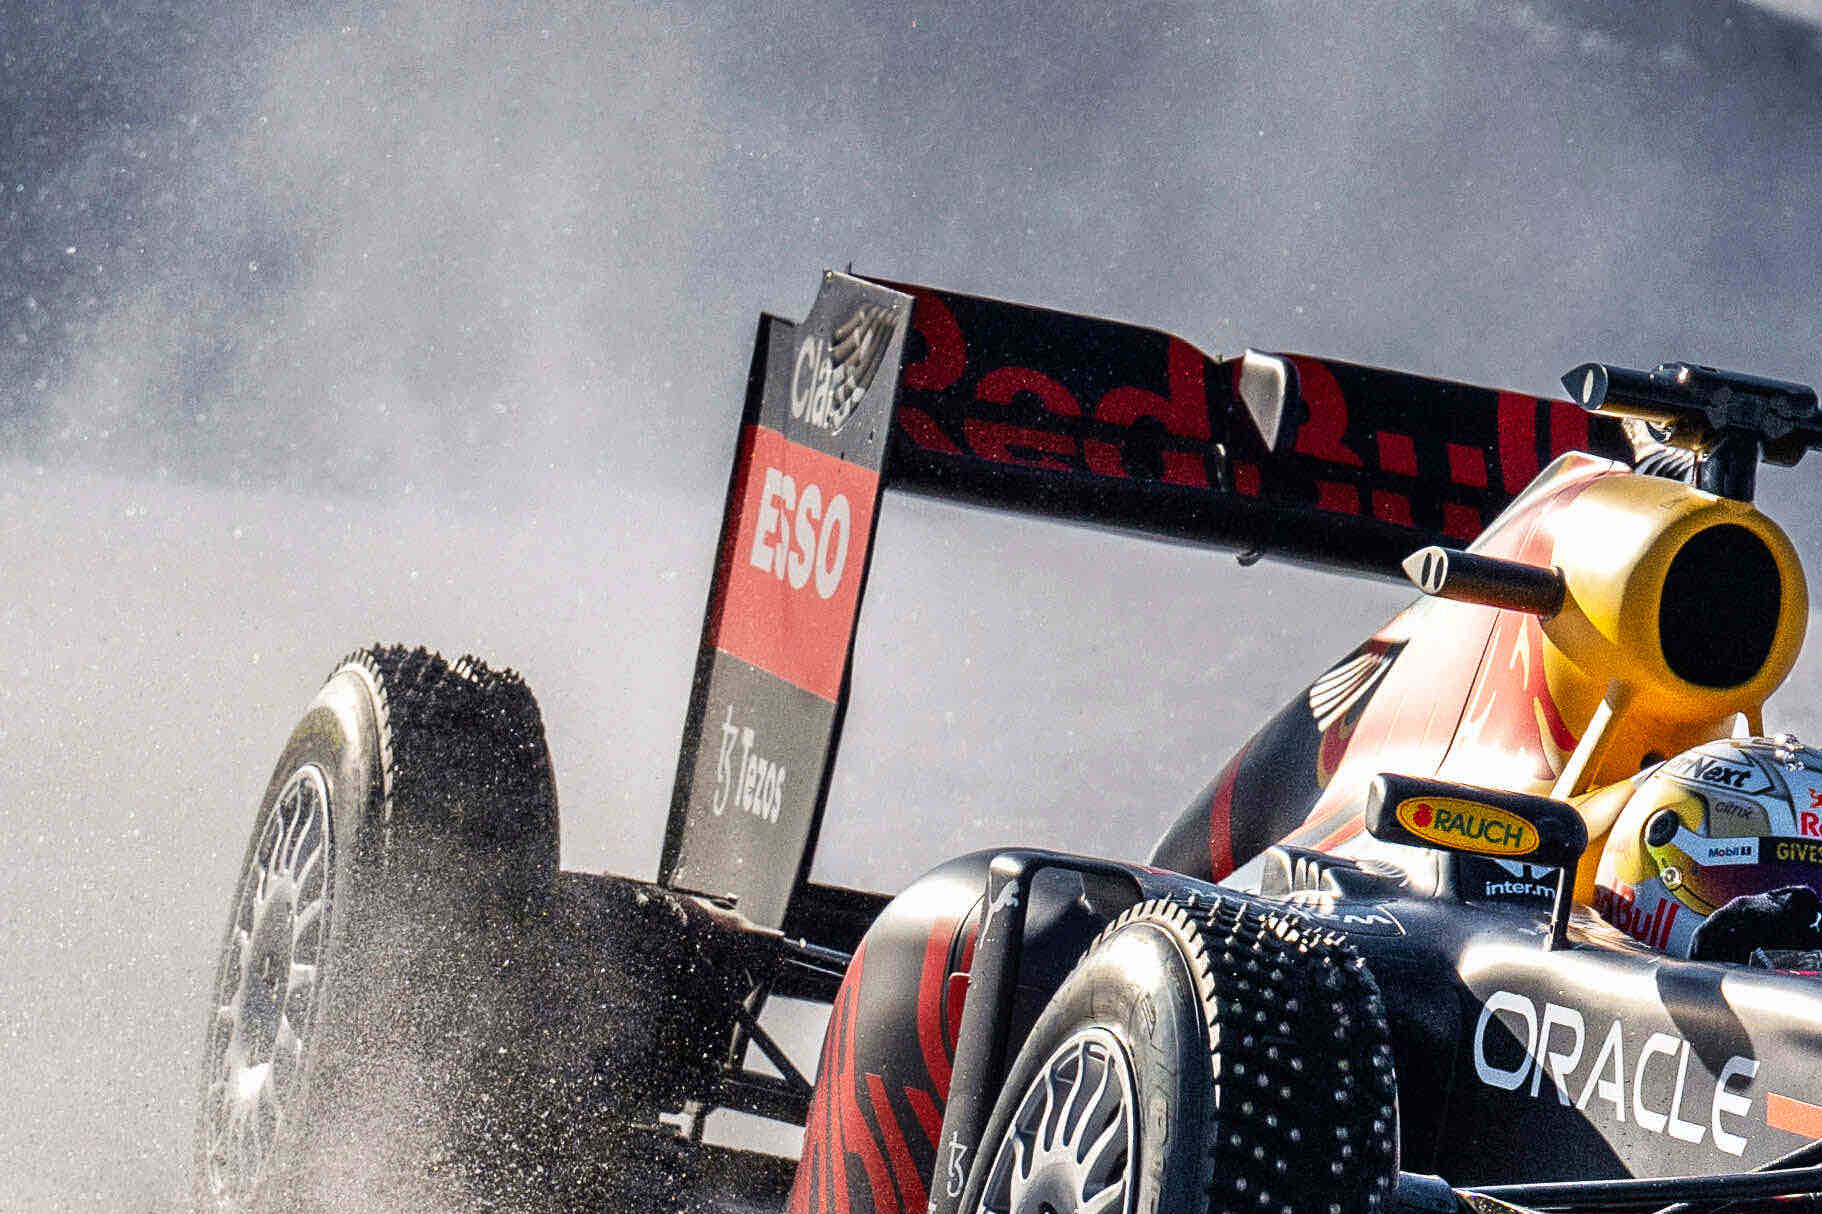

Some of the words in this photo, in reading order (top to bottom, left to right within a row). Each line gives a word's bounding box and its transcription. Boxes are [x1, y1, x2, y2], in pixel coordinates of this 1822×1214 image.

[734, 726, 786, 824] Tezos
[1433, 808, 1524, 848] RAUCH
[1473, 991, 1760, 1156] ORACLE
